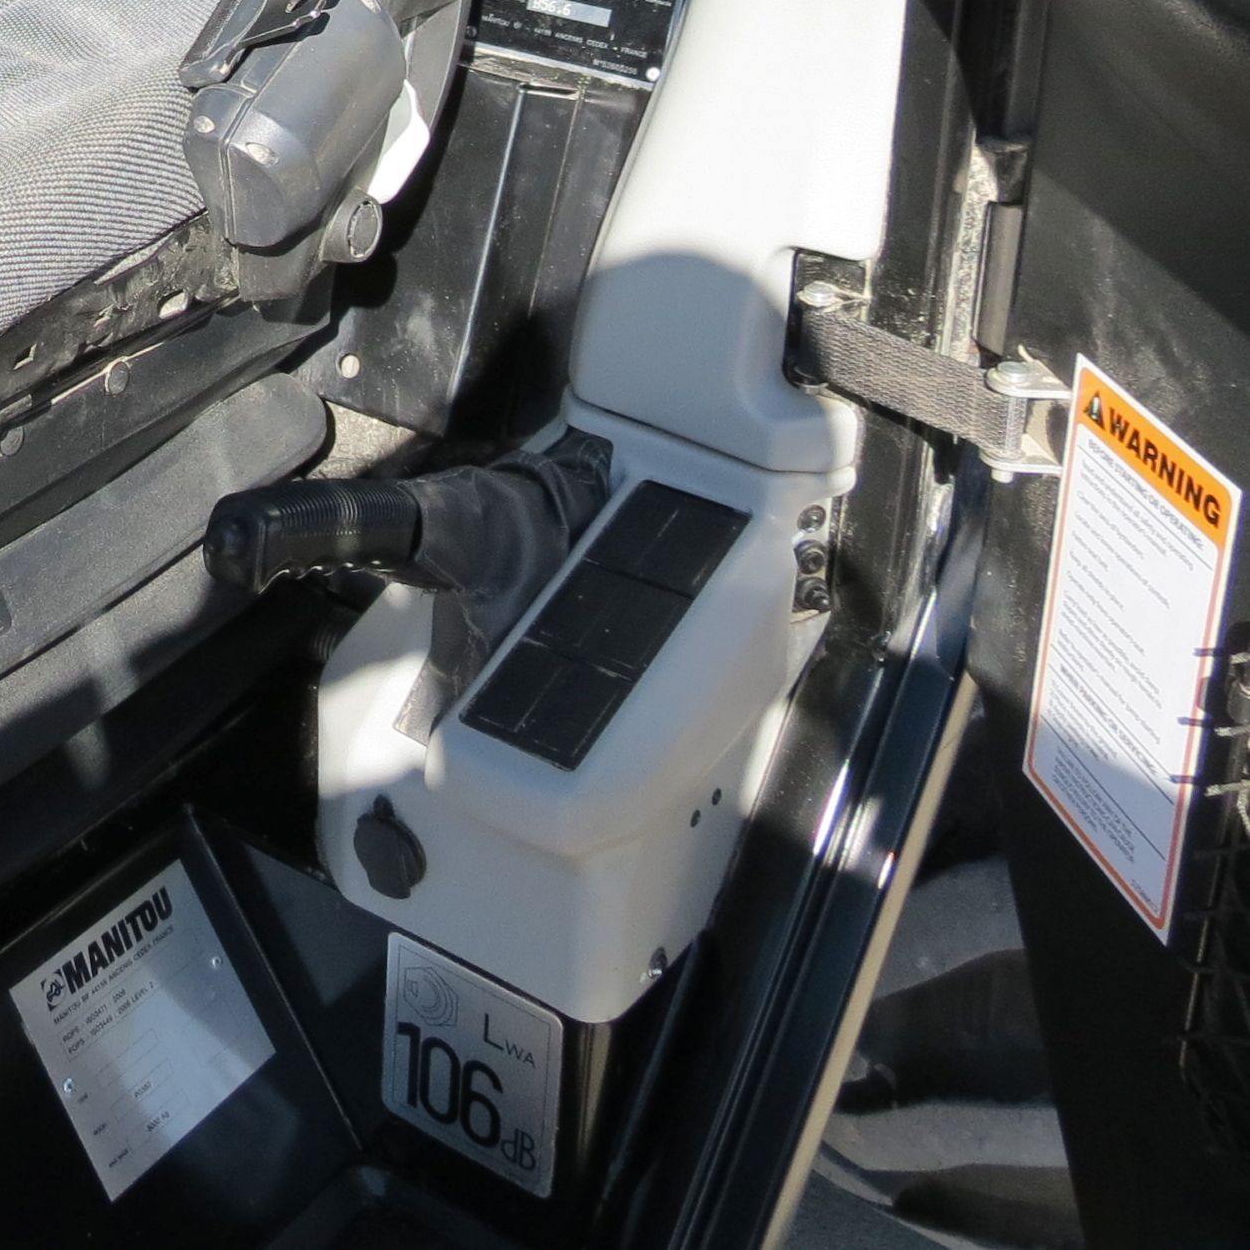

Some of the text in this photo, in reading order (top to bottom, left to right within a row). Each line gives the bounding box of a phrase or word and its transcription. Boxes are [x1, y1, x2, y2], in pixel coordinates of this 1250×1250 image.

[1109, 407, 1221, 529] WARNING
[62, 886, 173, 995] MANITOU
[53, 1001, 82, 1025] MANITOU
[397, 1021, 504, 1149] 106
[500, 1127, 537, 1172] dB
